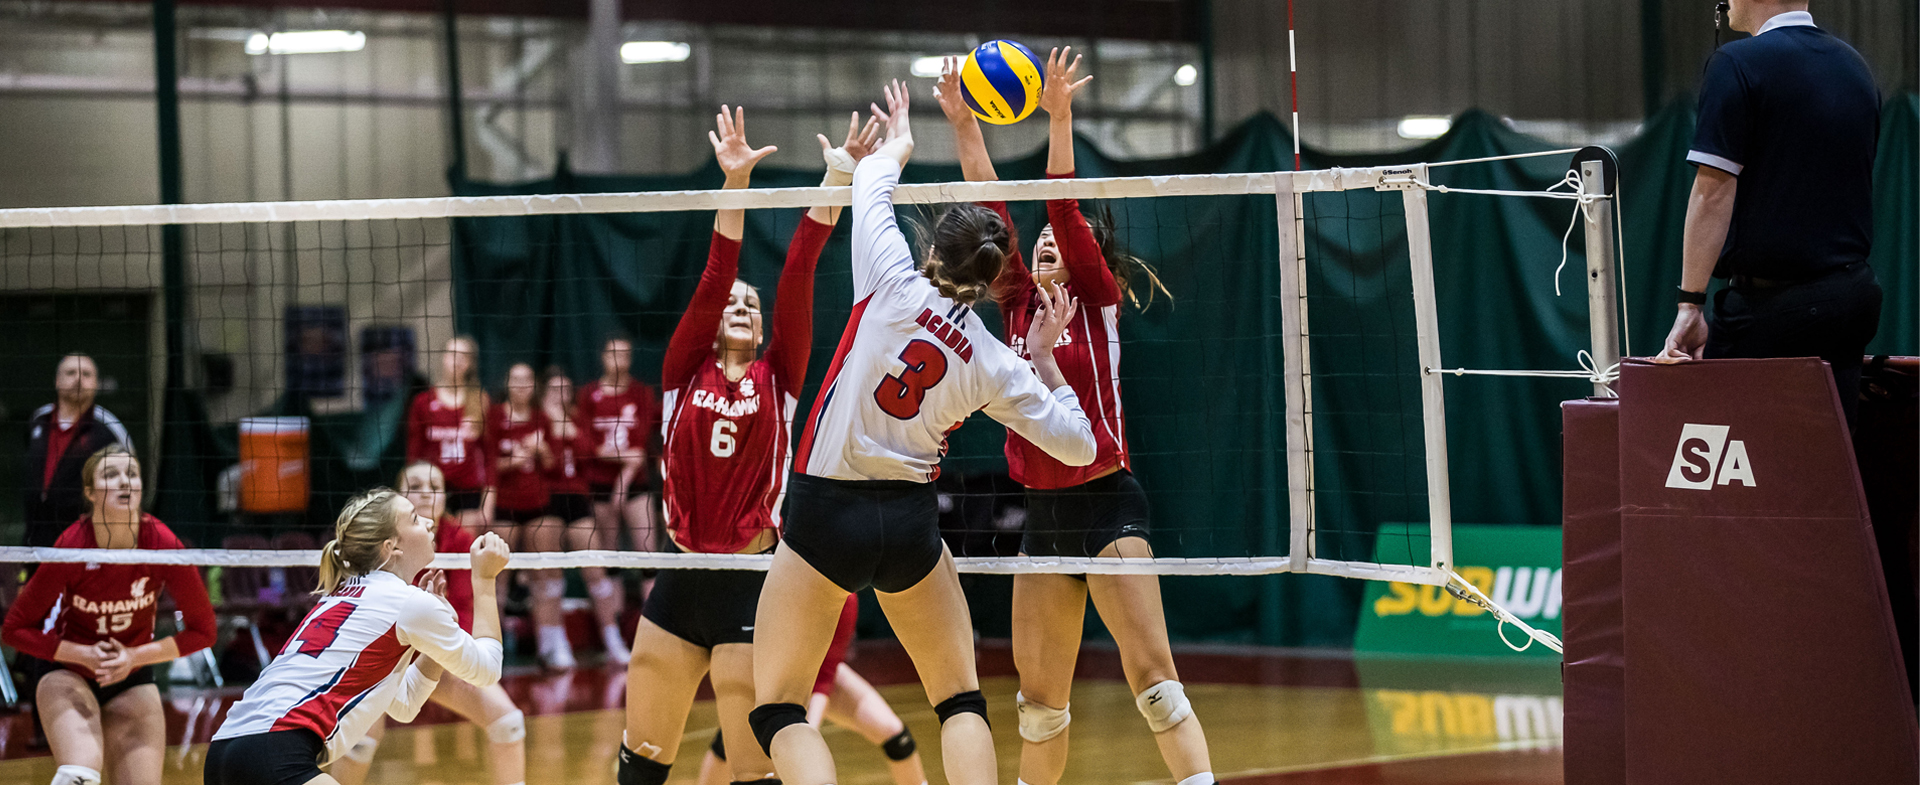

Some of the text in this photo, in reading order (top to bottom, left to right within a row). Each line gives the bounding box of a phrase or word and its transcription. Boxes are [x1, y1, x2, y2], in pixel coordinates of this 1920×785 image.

[915, 307, 974, 365] ACADIA
[873, 338, 948, 420] 3
[710, 418, 738, 458] 6
[96, 612, 134, 635] 15
